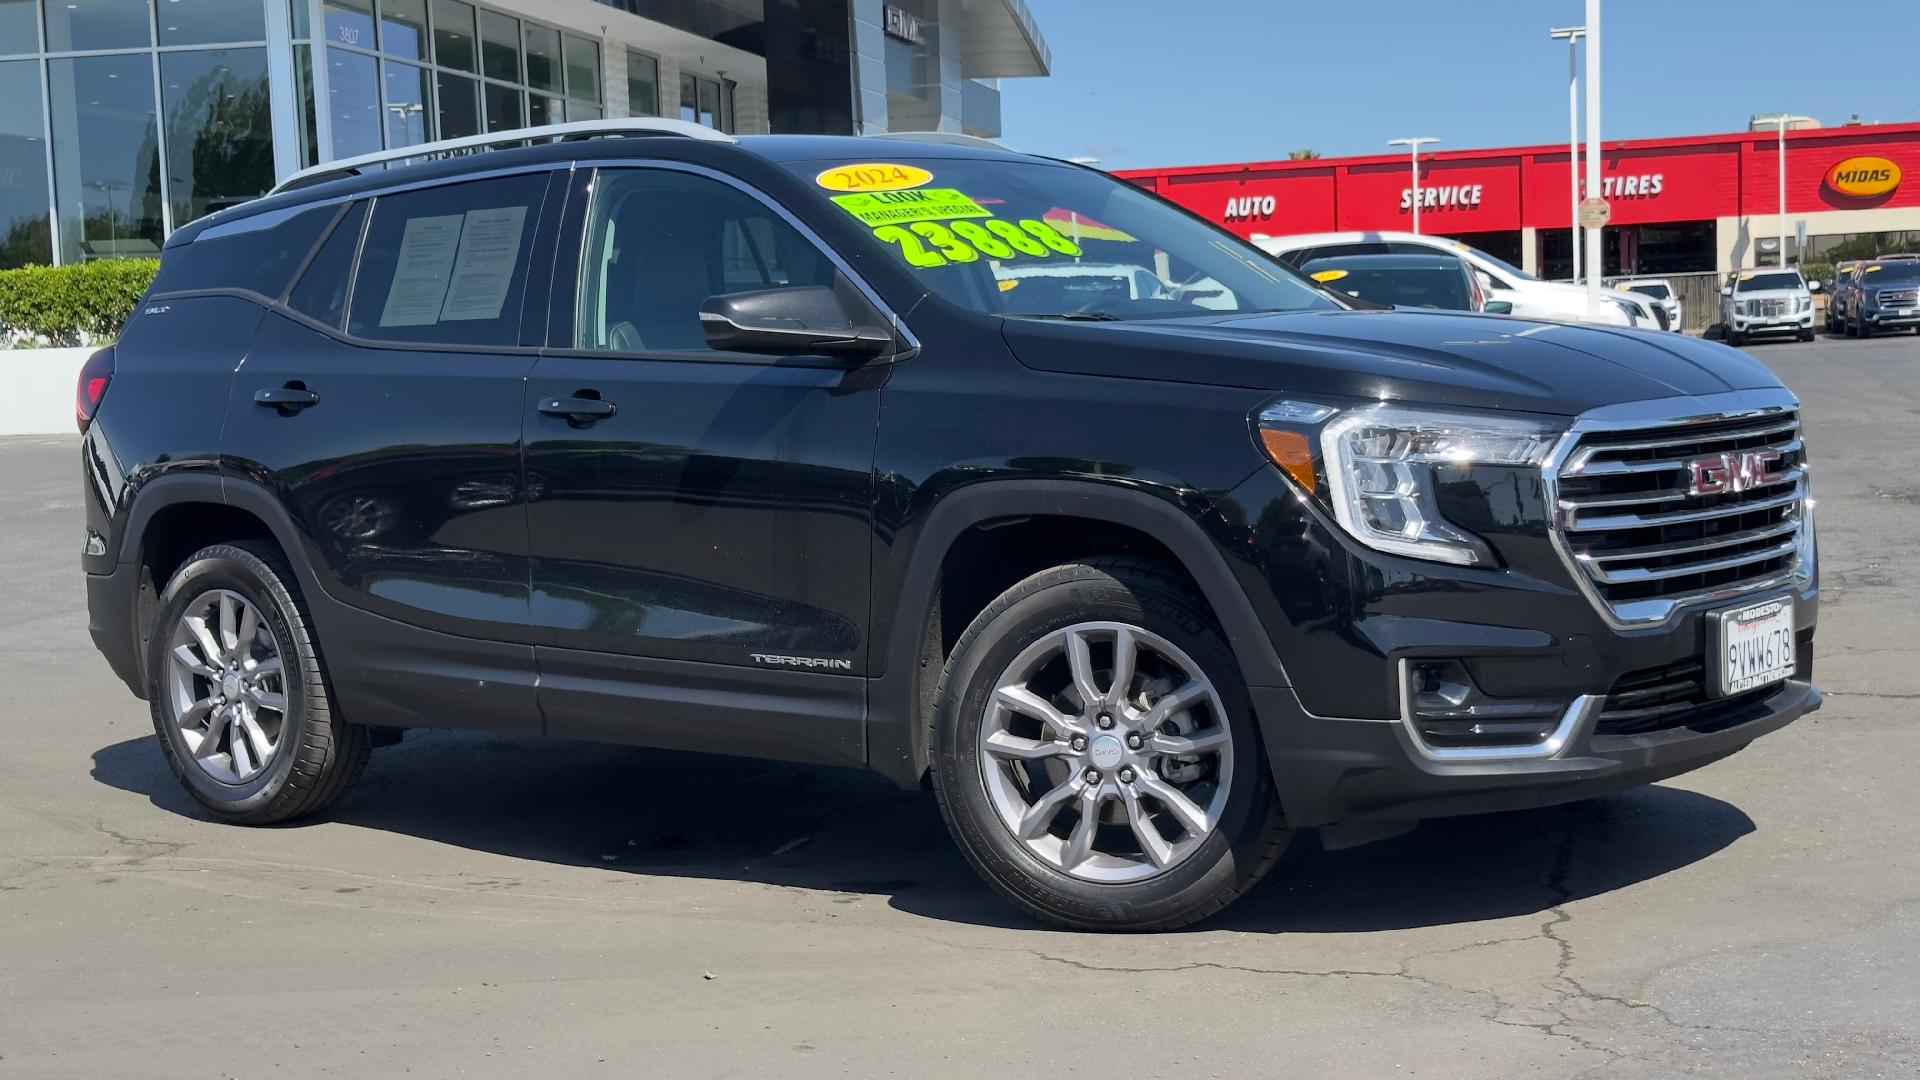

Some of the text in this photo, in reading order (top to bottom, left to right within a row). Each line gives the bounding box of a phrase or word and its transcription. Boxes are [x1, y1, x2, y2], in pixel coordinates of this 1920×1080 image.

[886, 6, 926, 45] GMC
[836, 167, 909, 188] 2024
[1603, 173, 1663, 197] TIRES
[1836, 169, 1892, 184] MIDAS
[870, 190, 932, 204] LOOK
[1225, 195, 1276, 217] AUTO
[1400, 185, 1483, 209] SERVICE
[873, 219, 1083, 267] 23888
[1689, 450, 1782, 496] GMC
[1742, 602, 1782, 621] MODESTO
[750, 653, 851, 670] TERRAIN
[1729, 627, 1791, 685] 9VWW678
